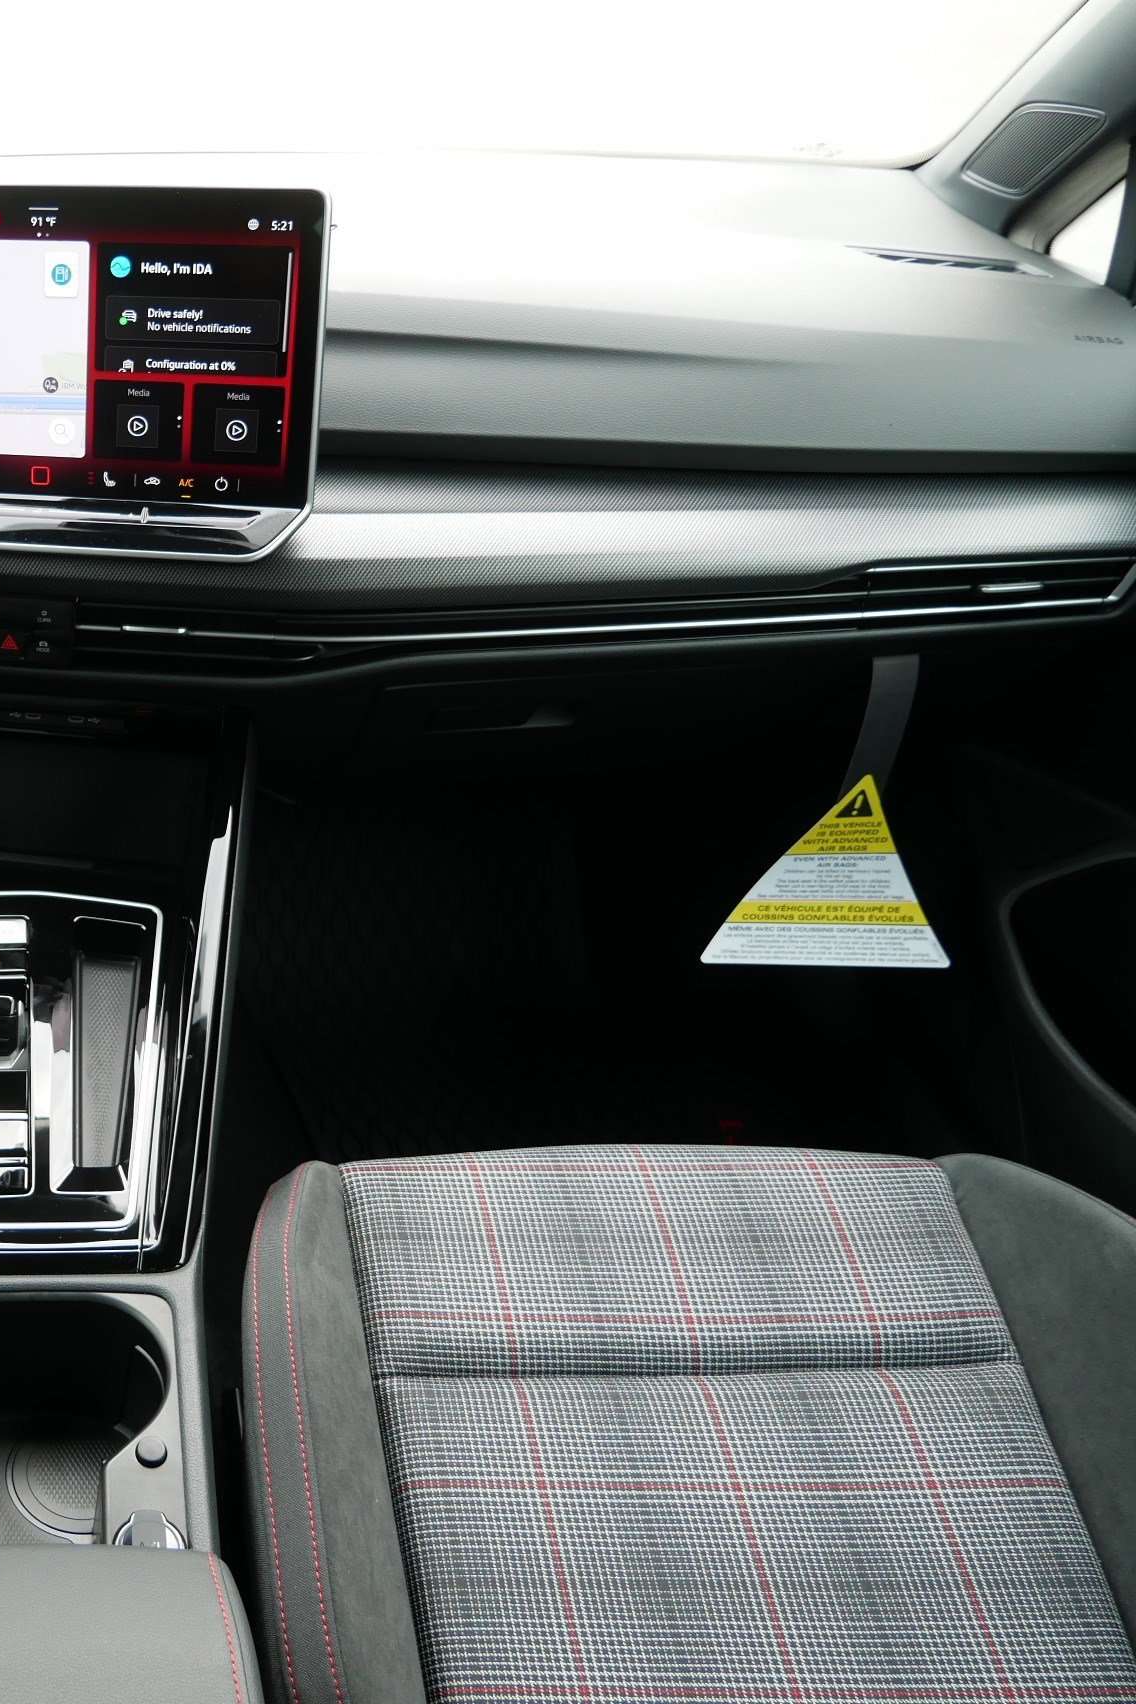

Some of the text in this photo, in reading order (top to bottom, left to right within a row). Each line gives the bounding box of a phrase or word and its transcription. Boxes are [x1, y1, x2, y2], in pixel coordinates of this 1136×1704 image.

[30, 217, 43, 227] 91
[270, 220, 294, 231] 5:21
[140, 262, 213, 276] Hello, I'm IDA
[147, 308, 204, 321] Drive safely!
[147, 322, 251, 335] No vehicle notifications
[1073, 334, 1124, 345] AIRBAG
[145, 358, 236, 371] Configuration at 0%
[127, 388, 150, 397] Media
[226, 392, 250, 401] Media
[178, 478, 195, 488] A/C
[828, 829, 879, 837] EQUIPPED
[757, 904, 771, 912] CE
[773, 904, 823, 912] VÉHICULE
[825, 905, 845, 913] EST
[847, 904, 884, 913] ÉQUIPÉ
[797, 914, 865, 922] GONFLABLES
